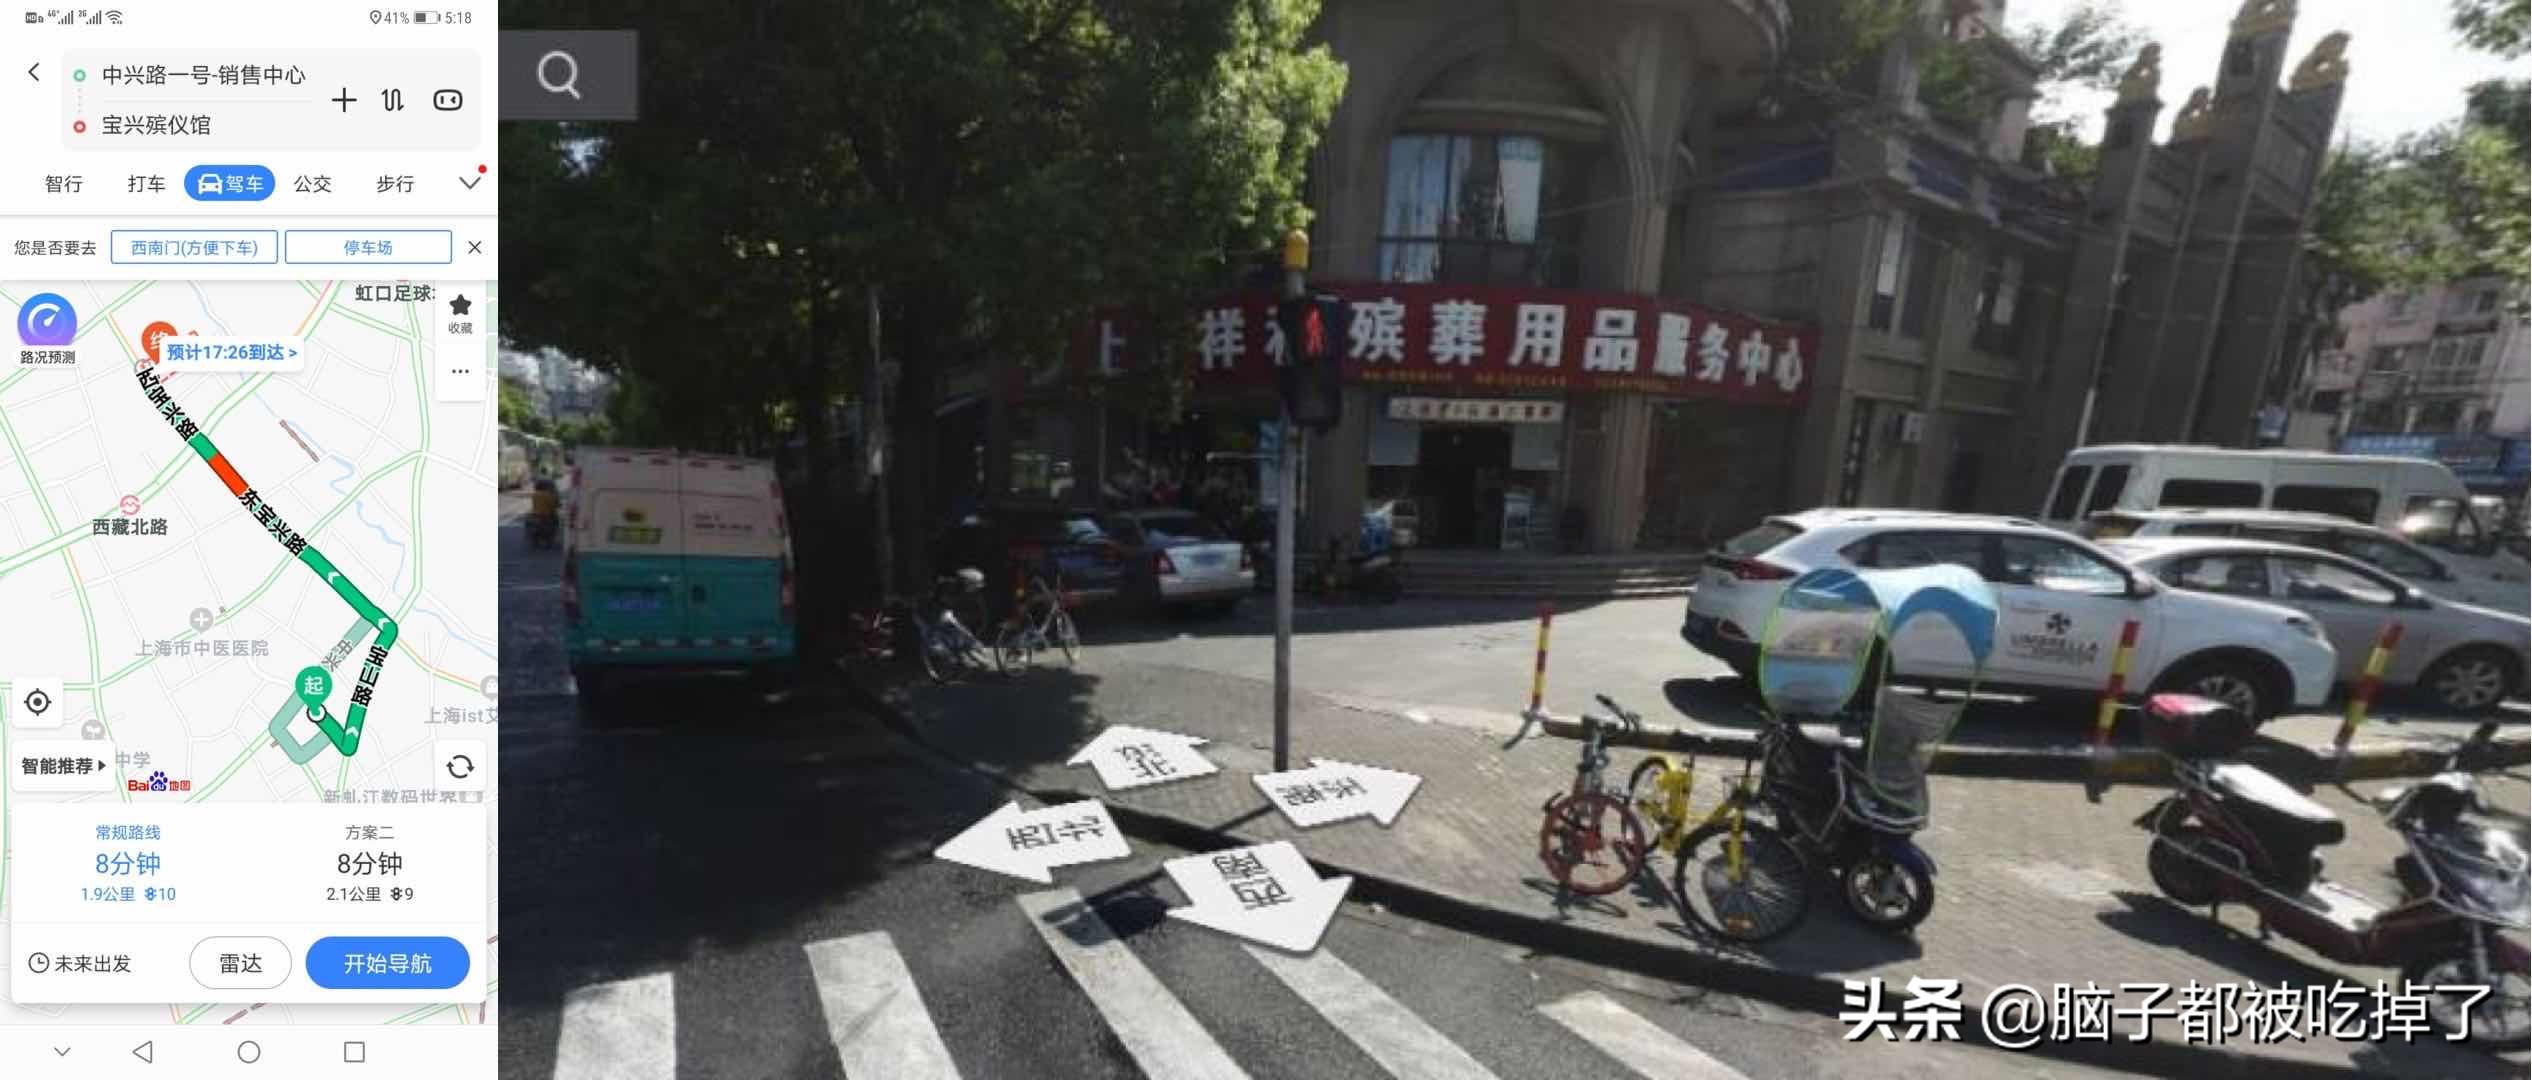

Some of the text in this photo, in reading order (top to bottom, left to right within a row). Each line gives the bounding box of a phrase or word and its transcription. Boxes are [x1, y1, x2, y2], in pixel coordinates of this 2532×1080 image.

[384, 12, 409, 24] 41%
[446, 12, 471, 24] 5:18
[103, 64, 306, 85] 中兴路一号-销售中心
[102, 114, 210, 135] 宝兴殡仪馆
[45, 174, 83, 193] 智行
[128, 174, 165, 193] 打车
[226, 175, 264, 192] 驾车
[294, 175, 331, 193] 公交
[377, 175, 414, 193] 步行
[14, 240, 96, 256] 您是否要去
[132, 240, 257, 257] 西南门(方便下车)
[344, 240, 392, 255] 停车场
[355, 285, 435, 302] 虹口足球
[449, 322, 472, 334] 收藏
[21, 351, 75, 364] 路况预测
[168, 344, 284, 360] 预计17:26到达
[93, 518, 168, 535] 西藏北路
[238, 488, 308, 557] 东宝兴路
[136, 640, 268, 658] 上海市中医医院
[303, 676, 325, 696] 起
[21, 758, 94, 775] 智能推荐
[96, 825, 160, 840] 常规路线
[346, 825, 394, 840] 方案二
[96, 852, 160, 876] 8分钟
[338, 851, 402, 876] 8分钟
[82, 887, 134, 901] 1.9公里
[327, 886, 381, 901] 2.1公里
[55, 954, 131, 973] 未来出发
[220, 953, 263, 974] 雷达
[345, 952, 432, 976] 开始导航
